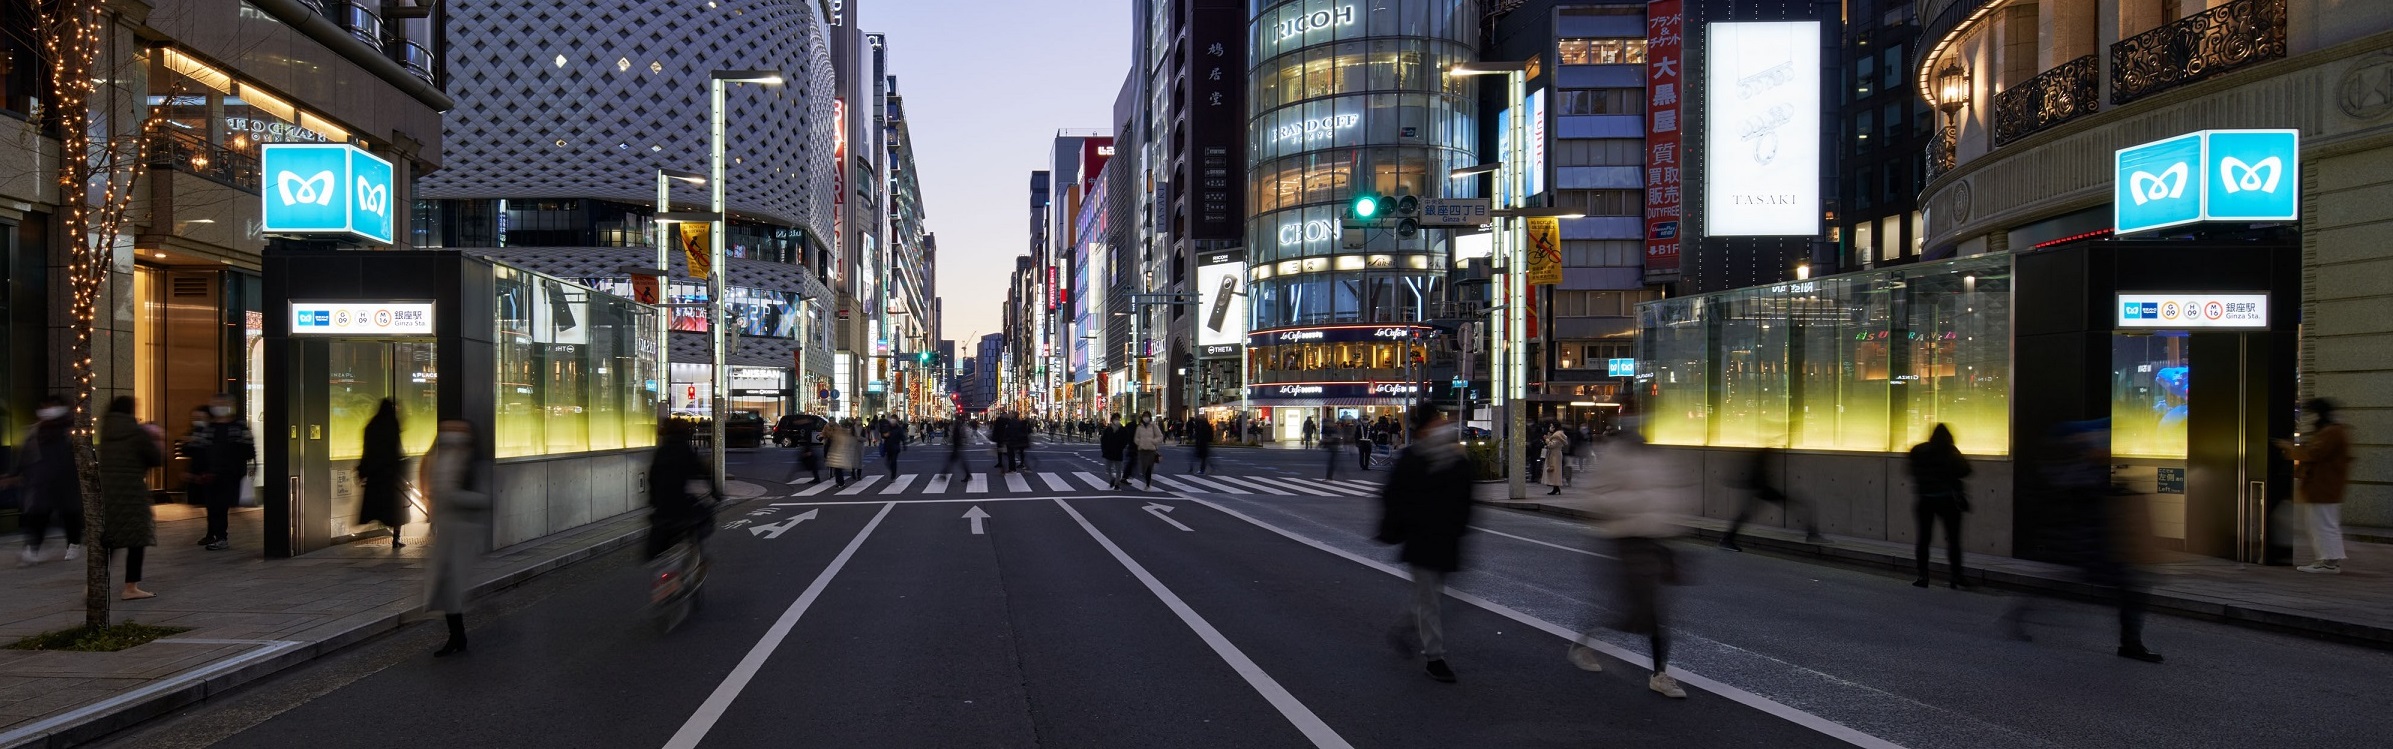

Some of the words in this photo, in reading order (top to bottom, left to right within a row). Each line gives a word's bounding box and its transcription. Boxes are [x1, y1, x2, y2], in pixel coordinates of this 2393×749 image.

[1273, 6, 1353, 43] RICOH
[1650, 14, 1681, 28] ブランド
[1661, 27, 1670, 35] &
[1650, 33, 1681, 48] チケット
[1207, 42, 1224, 106] 鳩居堂
[1653, 56, 1677, 133] 大黒屋
[1272, 119, 1317, 142] BRAND
[1322, 113, 1359, 129] OFF
[1653, 142, 1675, 165] 質
[1649, 166, 1679, 186] 買取
[1649, 186, 1679, 205] 販売
[1733, 195, 1795, 204] TASAKI
[1425, 205, 1485, 215] 銀座四丁目
[1648, 205, 1679, 219] DUTYFREE
[1659, 244, 1679, 255] B1F
[395, 310, 422, 320] 銀座駅
[2226, 303, 2256, 313] 銀座駅
[743, 369, 780, 378] NISSAN
